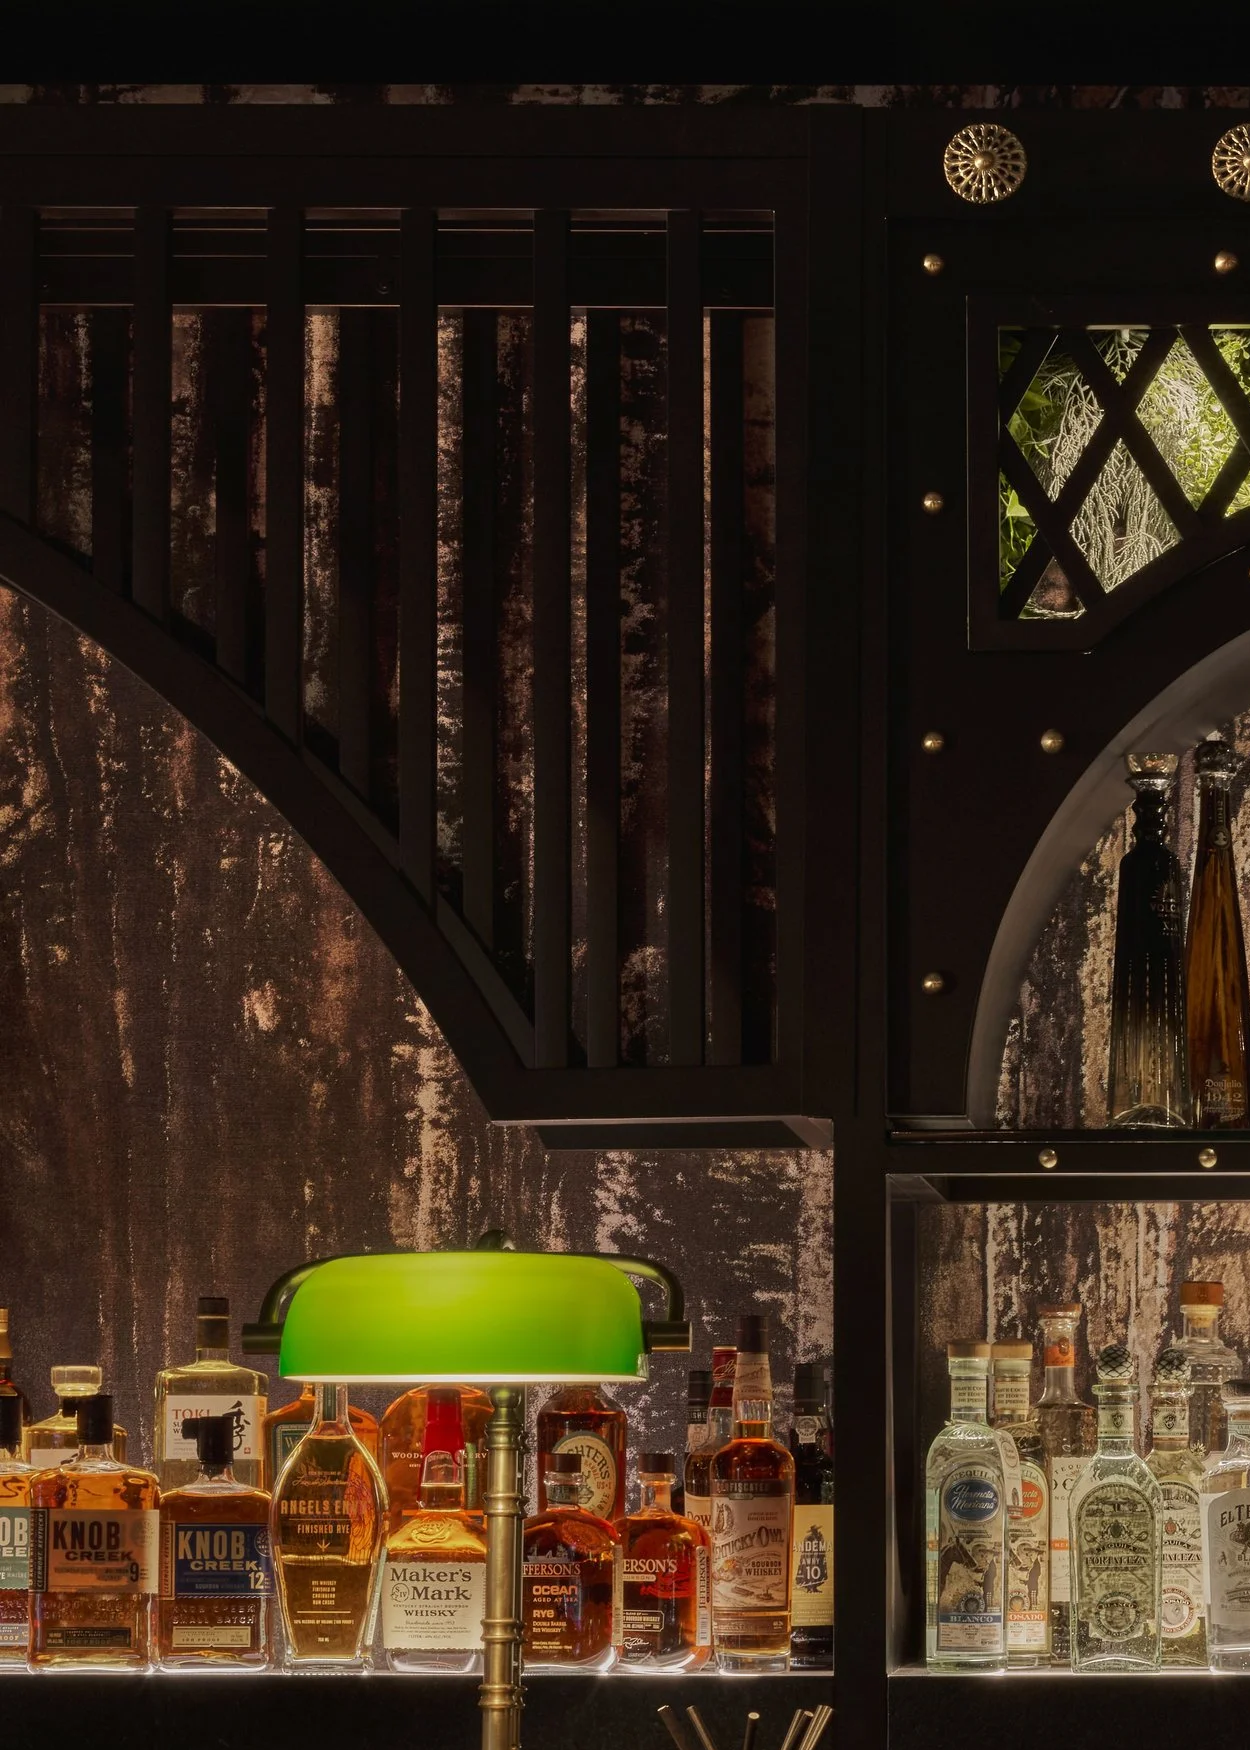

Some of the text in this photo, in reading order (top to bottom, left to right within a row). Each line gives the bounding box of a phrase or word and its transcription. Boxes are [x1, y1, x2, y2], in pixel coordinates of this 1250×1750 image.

[1204, 1092, 1242, 1102] 1942
[53, 1520, 121, 1550] KNOB
[297, 1524, 350, 1534] FINISHED RYE
[178, 1530, 245, 1560] KNOB
[65, 1551, 133, 1561] CREEK
[130, 1562, 139, 1582] 9
[623, 1558, 678, 1573] ERSON'S
[744, 1568, 782, 1576] WHISKEY
[390, 1567, 472, 1582] Maker's
[805, 1566, 821, 1580] 10
[248, 1572, 264, 1590] 12
[412, 1586, 471, 1601] Mark
[949, 1615, 994, 1623] BLANCO
[1009, 1613, 1044, 1621] OSADO
